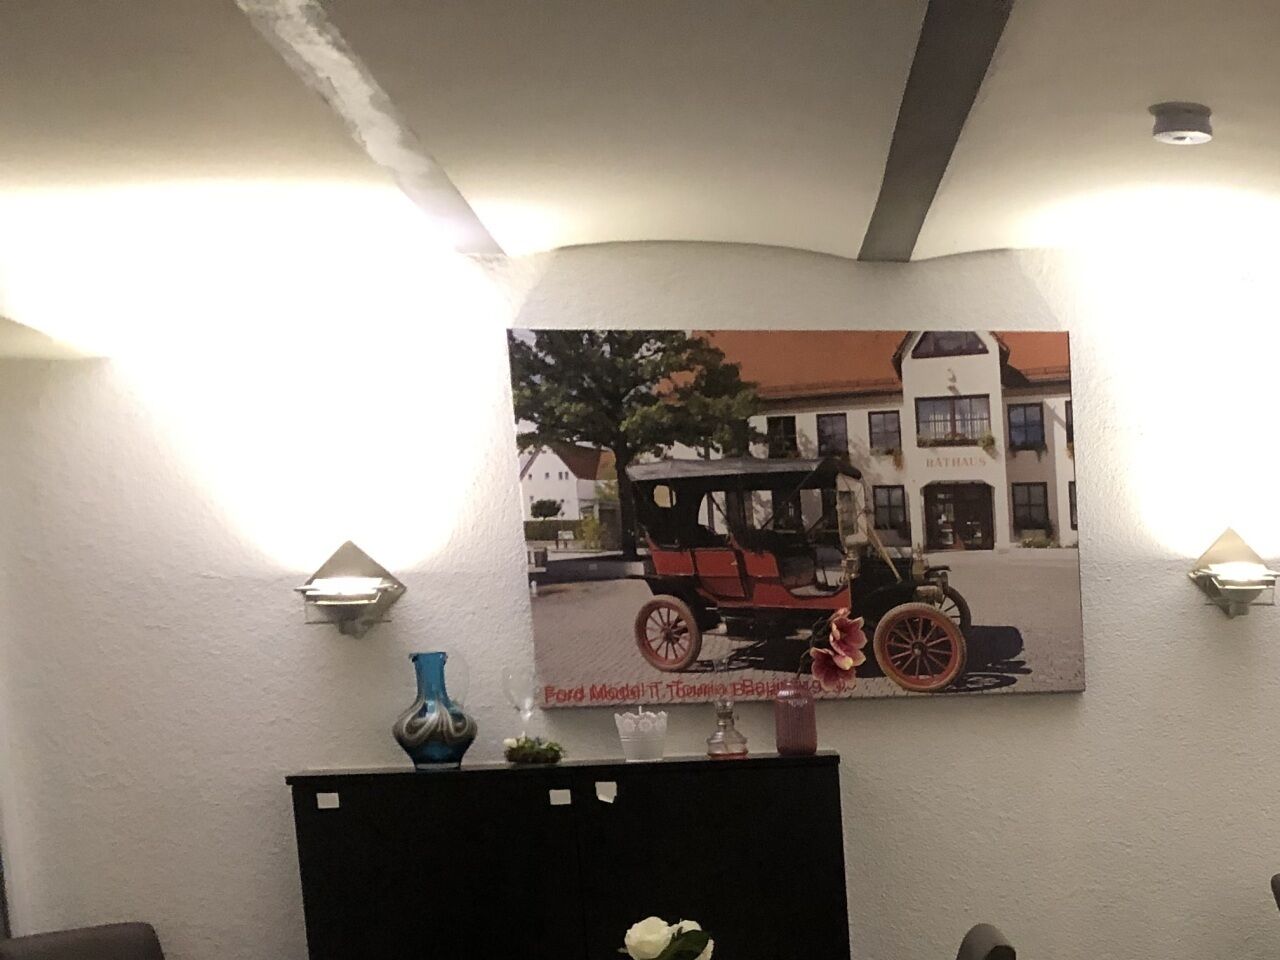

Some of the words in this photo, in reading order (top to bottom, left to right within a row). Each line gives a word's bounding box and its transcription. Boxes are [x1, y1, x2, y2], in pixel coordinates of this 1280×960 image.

[926, 456, 987, 468] RATHAUS
[544, 684, 585, 704] Ford
[589, 683, 645, 702] Model
